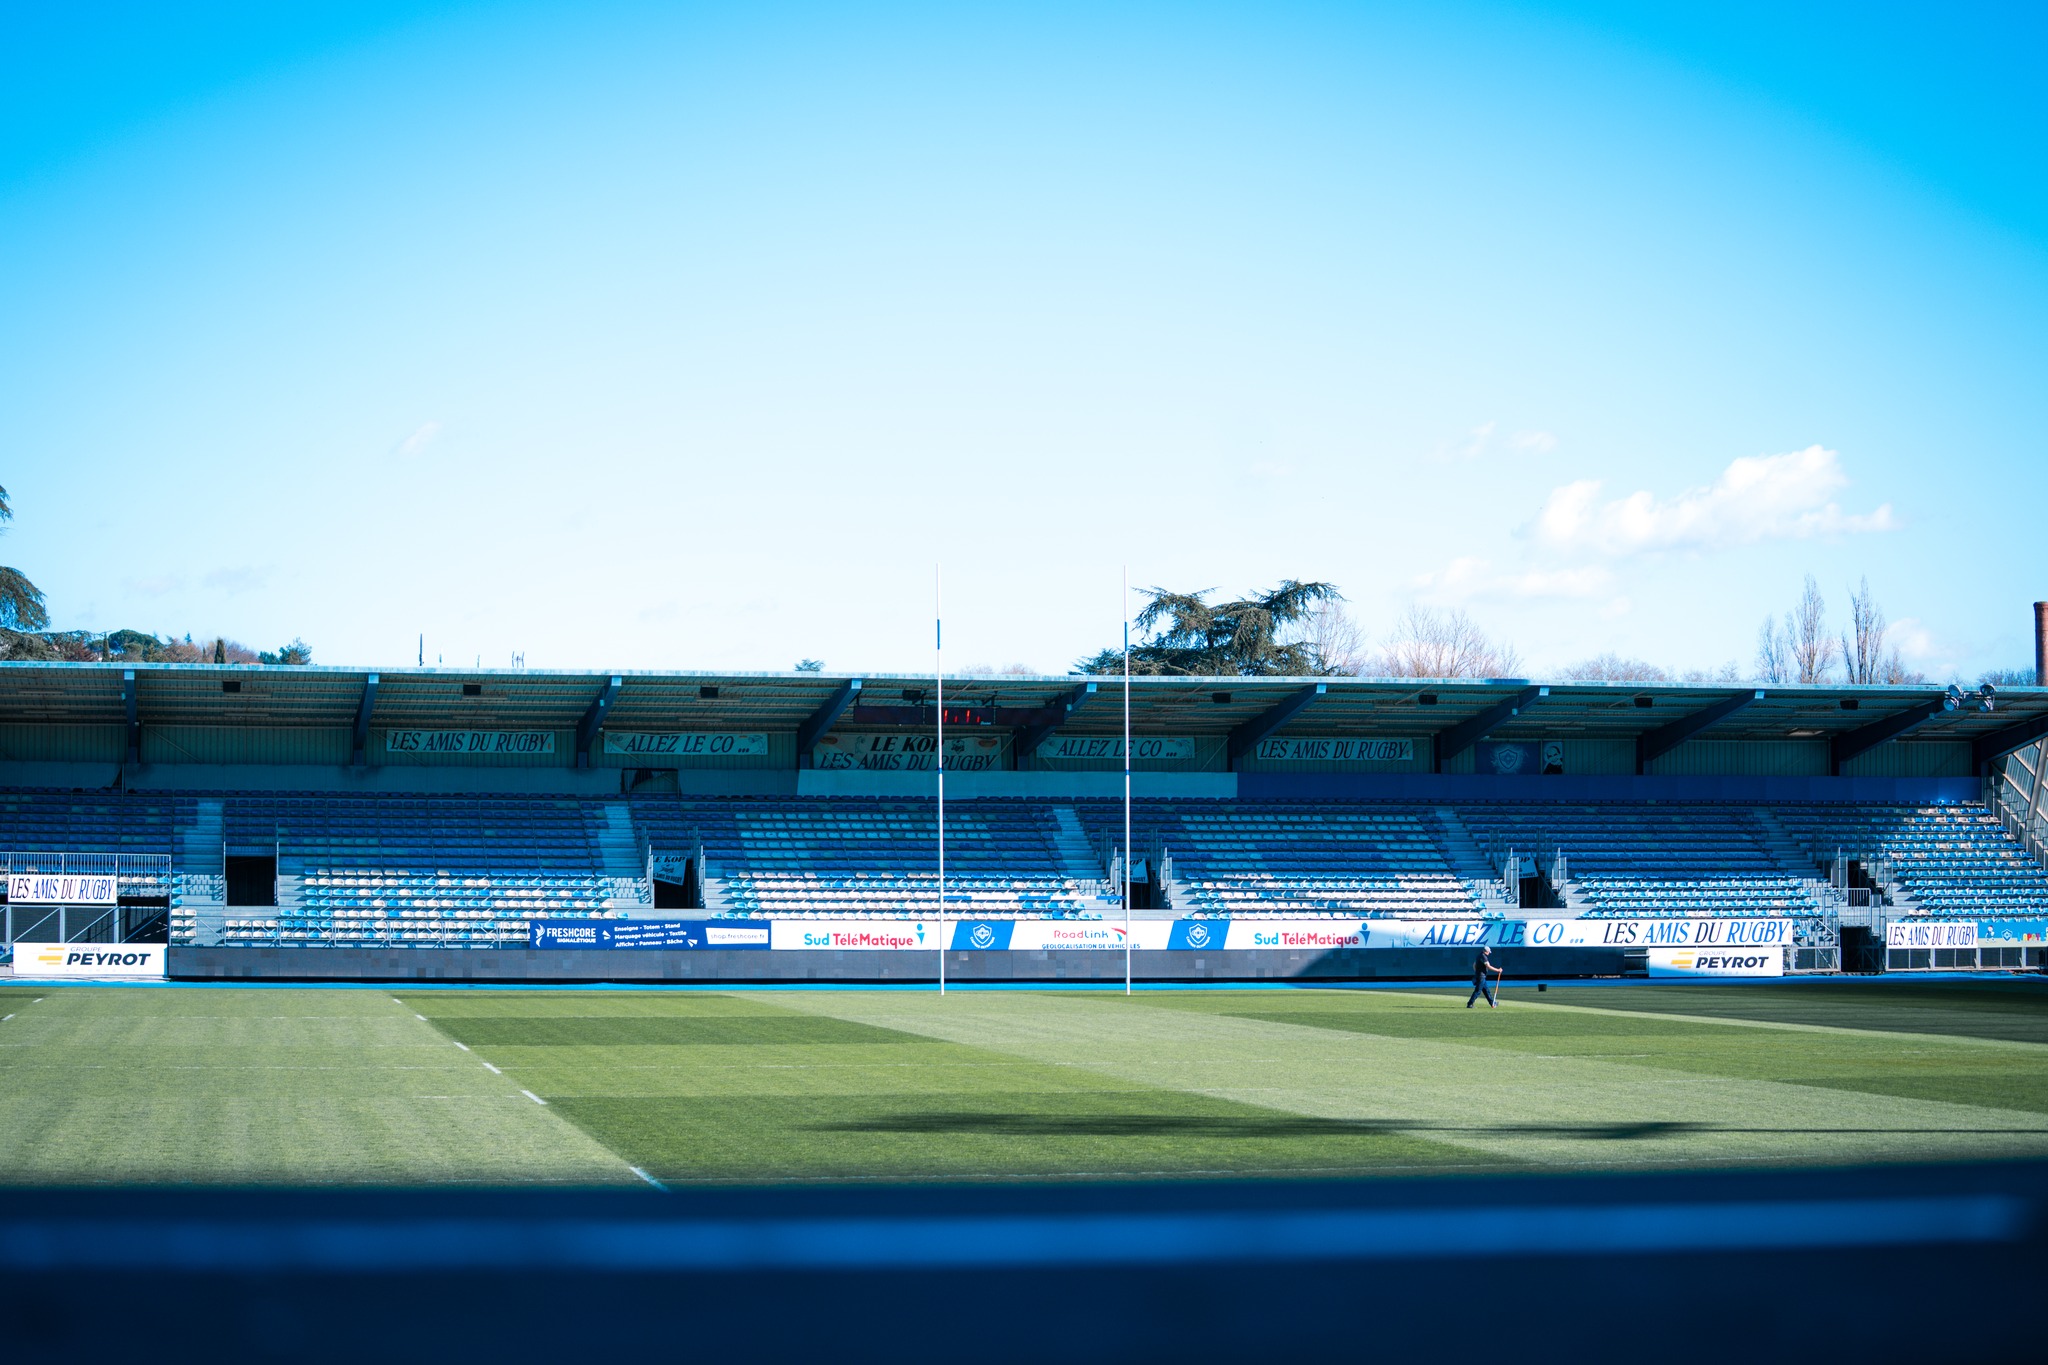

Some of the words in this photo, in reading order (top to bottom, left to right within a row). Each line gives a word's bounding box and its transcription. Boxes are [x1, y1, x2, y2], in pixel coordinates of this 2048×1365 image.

[390, 732, 421, 750] LES
[424, 732, 465, 750] AMIS
[468, 733, 493, 751] DU
[495, 733, 550, 752] RUGBY
[624, 735, 682, 752] ALLEZ
[682, 736, 706, 752] LE
[710, 736, 734, 752] CO
[870, 736, 898, 752] LE
[902, 736, 944, 752] KOP
[1056, 739, 1115, 757] ALLEZ
[1112, 740, 1136, 757] LE
[1139, 740, 1162, 756] CO
[1260, 740, 1290, 758] LES
[1290, 740, 1330, 758] AMIS
[1332, 741, 1356, 759] DU
[1356, 741, 1408, 760] RUGBY
[819, 752, 853, 769] LES
[857, 753, 904, 770] AMIS
[906, 754, 934, 770] DU
[10, 878, 30, 898] LES
[31, 878, 59, 899] AMIS
[61, 879, 78, 899] DU
[78, 879, 115, 900] RUGBY
[546, 928, 596, 937] FRESHCORE
[804, 933, 830, 946] Sud
[833, 933, 914, 949] TéléMatique
[1254, 932, 1278, 945] Sud
[1282, 932, 1359, 948] TéléMatique
[1420, 923, 1494, 946] ALLEZ
[1497, 922, 1527, 946] LE
[1532, 923, 1565, 944] CO
[1603, 922, 1639, 944] LES
[1642, 922, 1691, 944] AMIS
[1694, 922, 1723, 944] DU
[1726, 921, 1790, 944] RUGBY
[1888, 926, 1905, 946] LES
[1906, 926, 1930, 946] AMIS
[1931, 926, 1946, 946] DU
[1947, 926, 1977, 946] RUGBY
[66, 953, 151, 966] PEYROT
[1696, 956, 1769, 968] PEYROT
